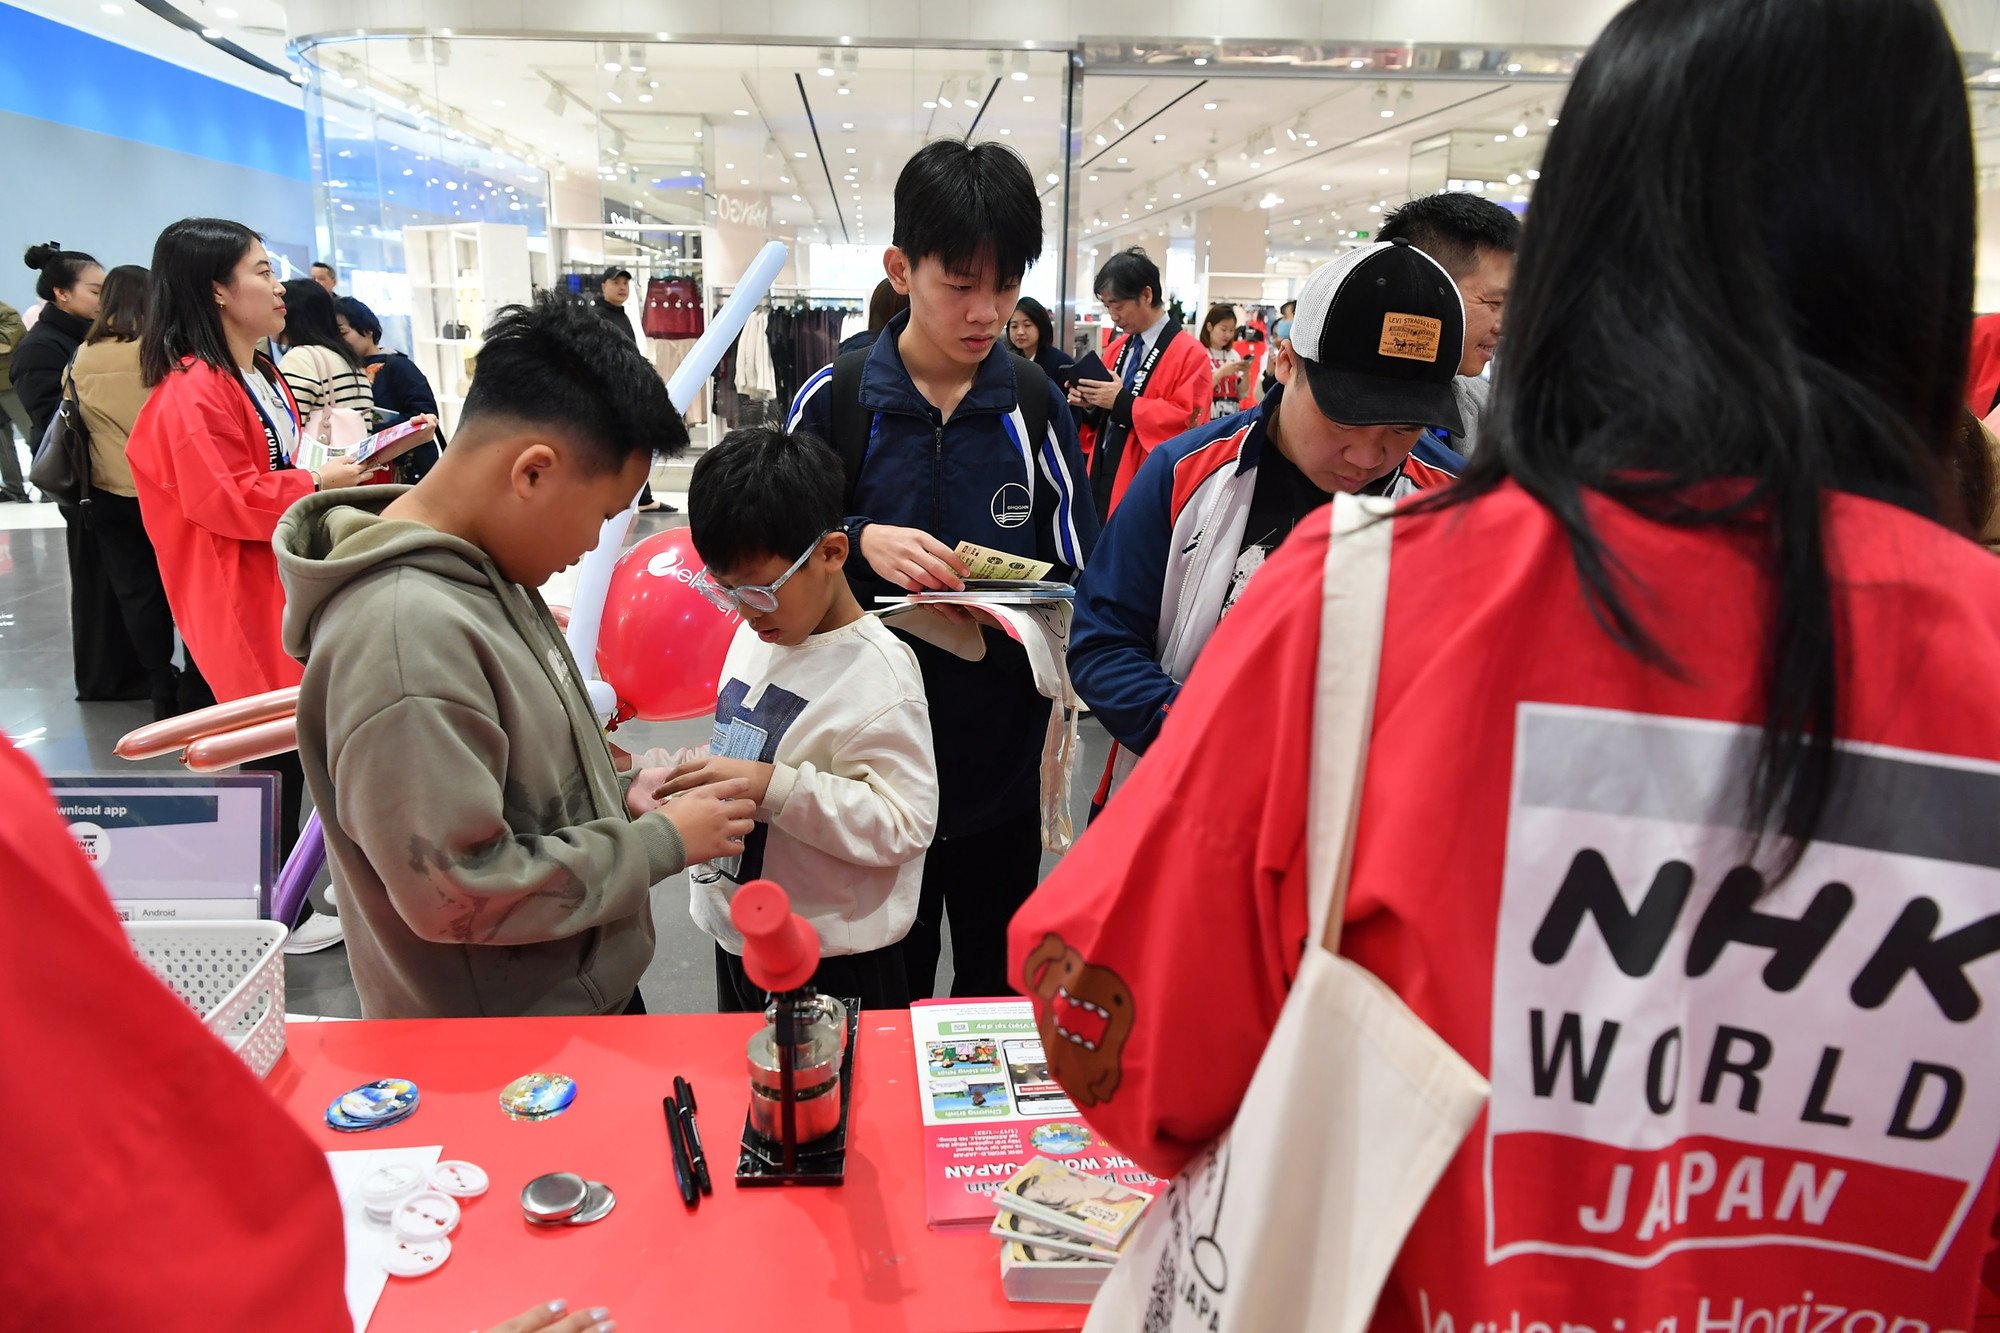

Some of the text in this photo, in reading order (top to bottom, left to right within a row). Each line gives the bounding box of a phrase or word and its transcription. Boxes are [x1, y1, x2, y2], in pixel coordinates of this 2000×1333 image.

[1388, 316, 1402, 324] LEVI
[1404, 317, 1426, 326] STRAUSS
[1143, 347, 1160, 370] NHK
[264, 427, 278, 471] WORLD
[55, 804, 127, 818] wnload app
[142, 908, 176, 918] Android
[1530, 847, 2000, 1024] NHK
[1527, 1007, 1967, 1142] WORLD
[1102, 1156, 1137, 1169] HK
[1577, 1150, 1848, 1242] JAPAN
